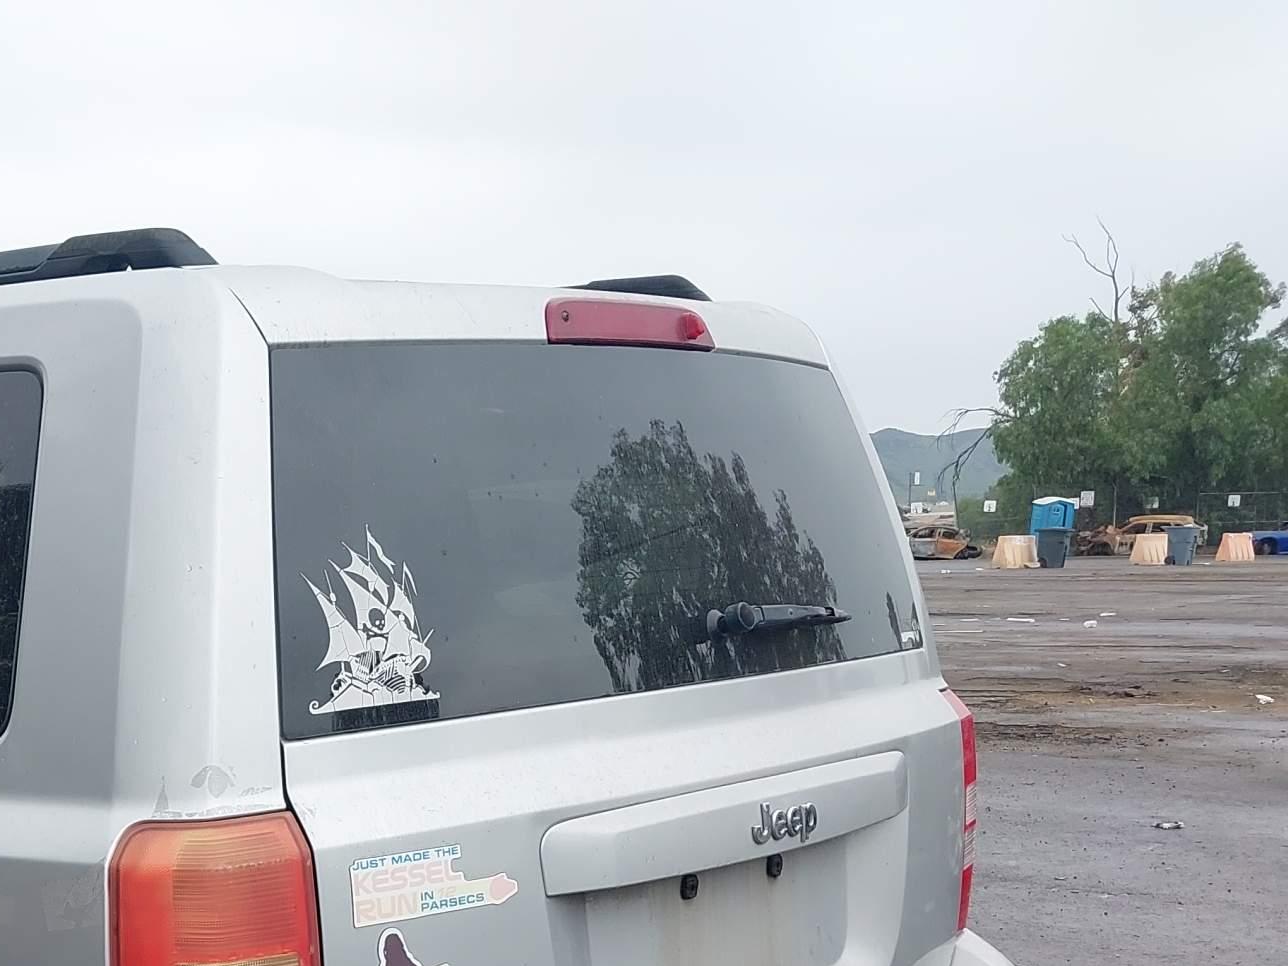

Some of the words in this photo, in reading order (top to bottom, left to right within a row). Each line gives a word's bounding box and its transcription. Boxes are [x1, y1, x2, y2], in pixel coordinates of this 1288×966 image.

[751, 801, 817, 845] Jeep
[352, 857, 387, 871] JUST
[391, 851, 430, 865] MADE
[434, 846, 459, 858] THE
[354, 859, 462, 896] KESSEL
[356, 890, 418, 923] RUN
[420, 890, 435, 902] IN
[421, 893, 485, 913] PARSECS
